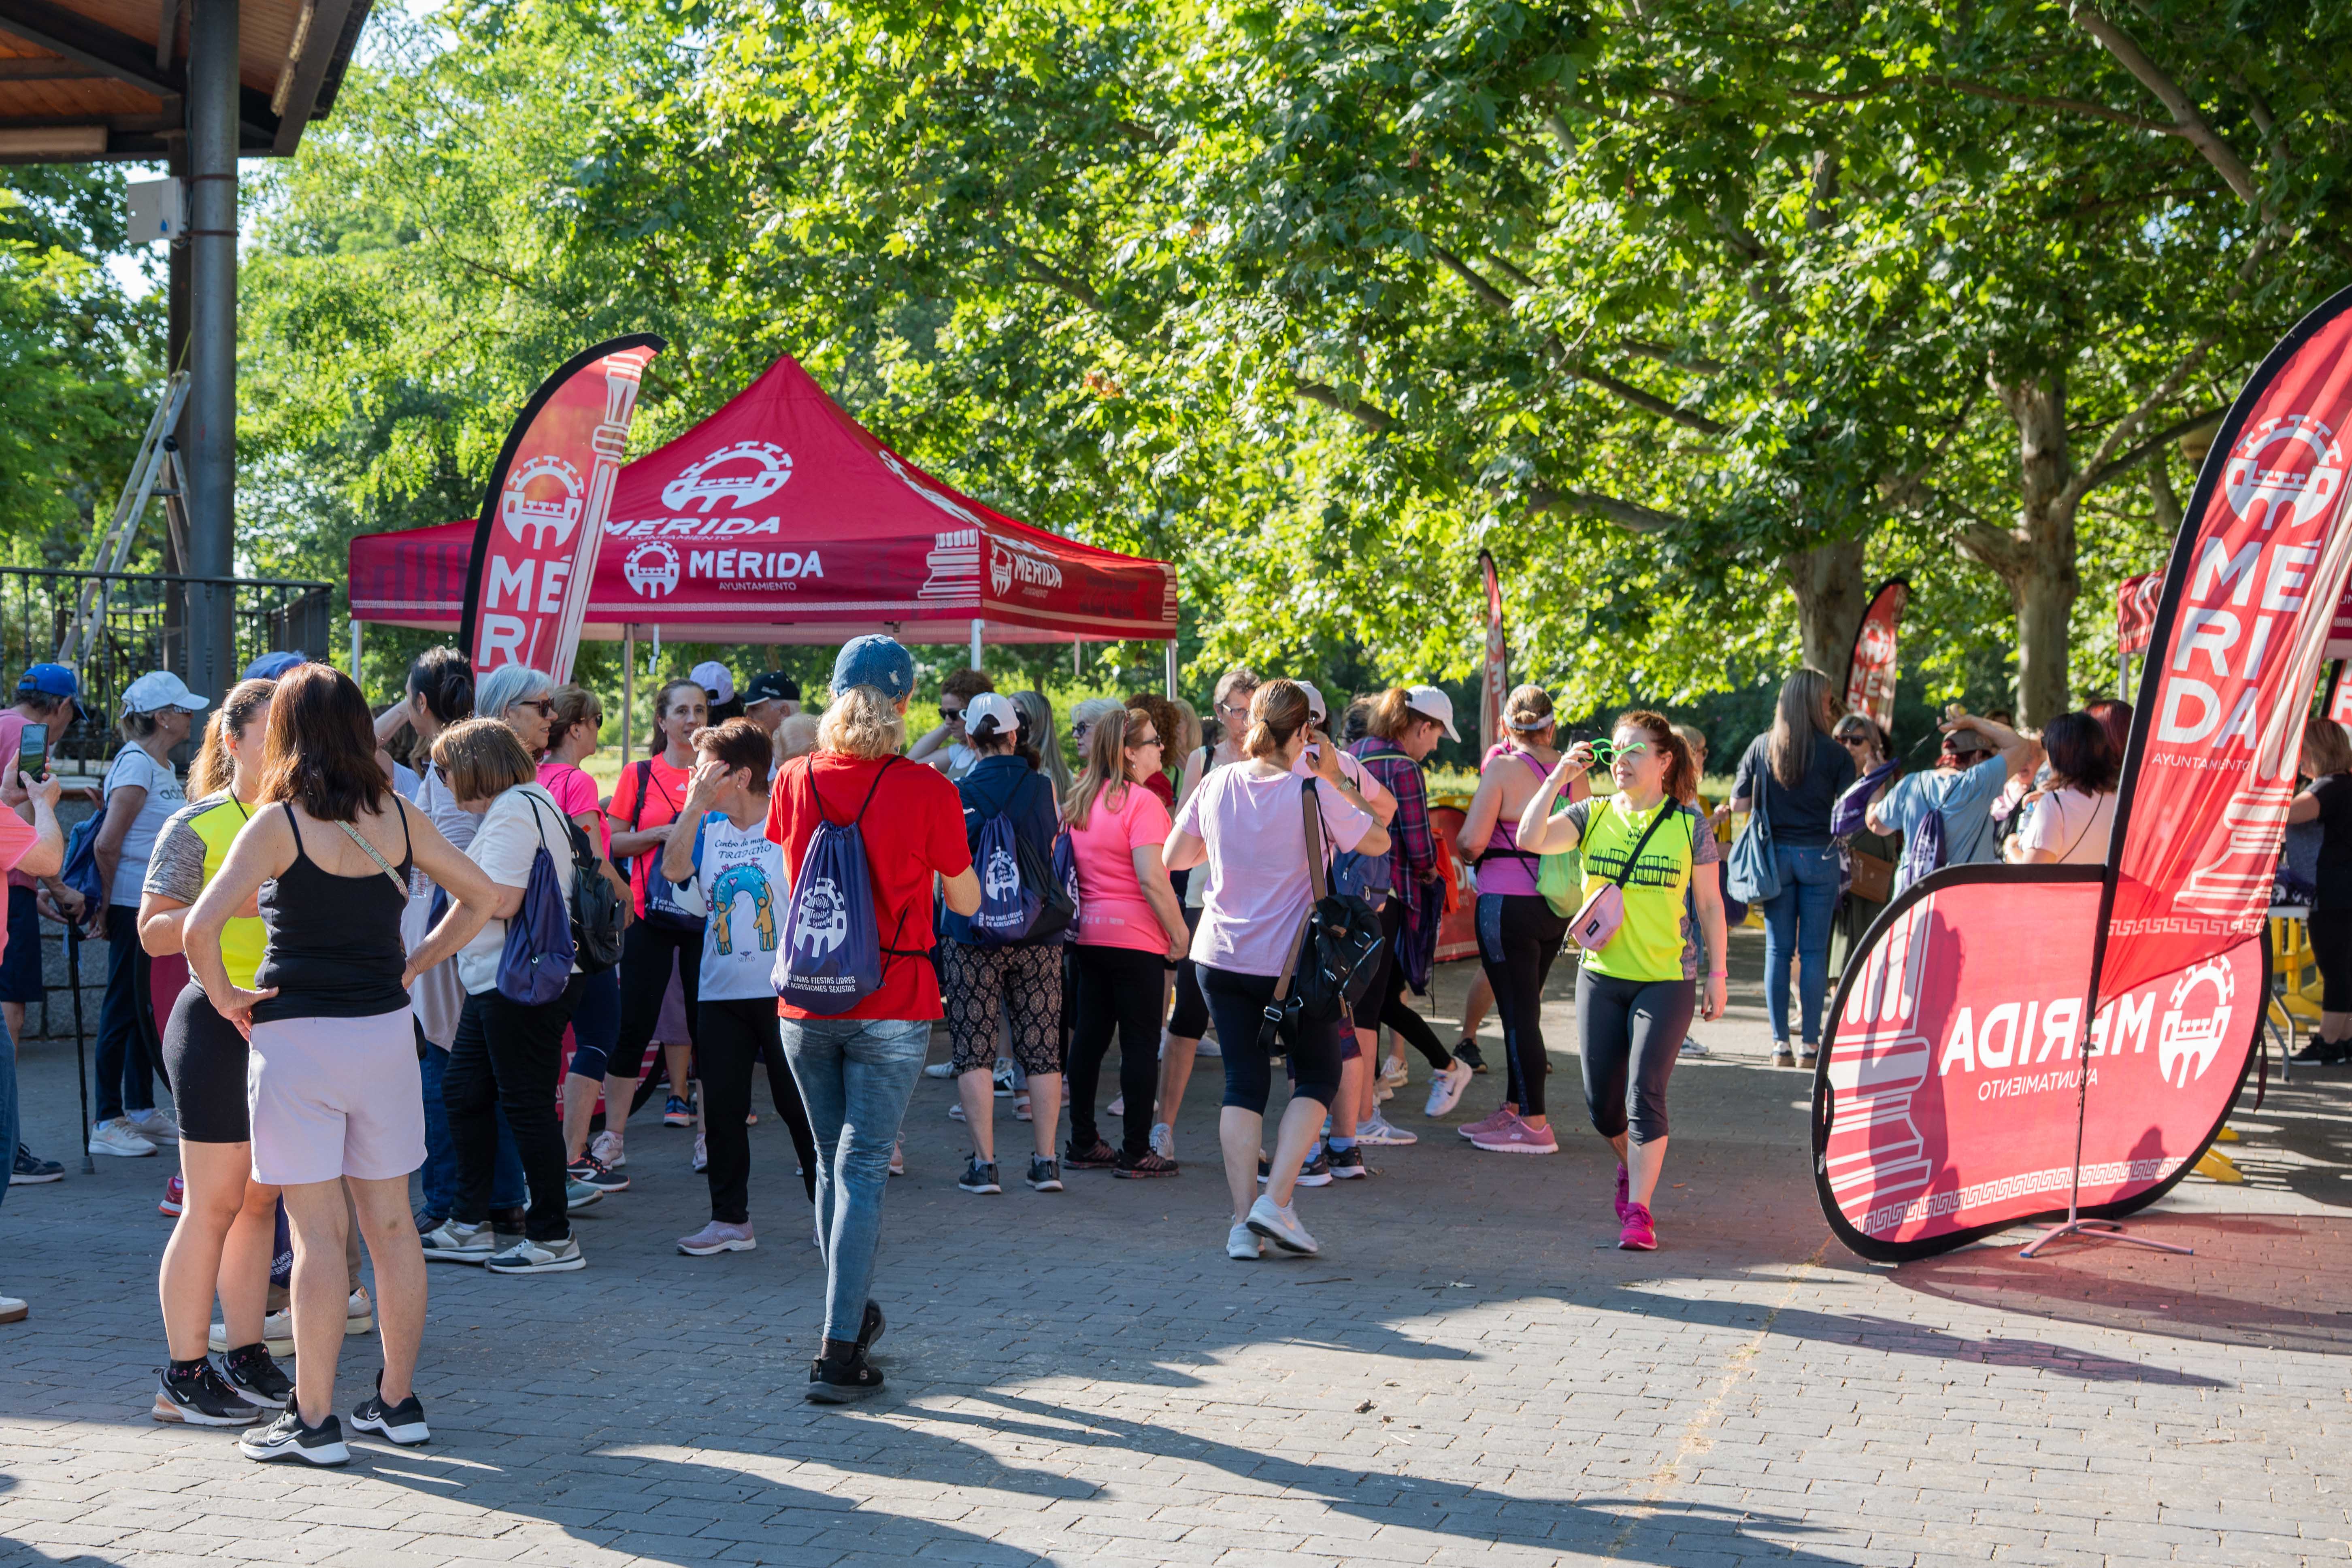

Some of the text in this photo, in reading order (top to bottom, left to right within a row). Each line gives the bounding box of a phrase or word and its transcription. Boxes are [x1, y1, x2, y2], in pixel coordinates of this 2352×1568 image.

[689, 548, 824, 579] MÉRIDA
[2191, 537, 2321, 612] MÉ
[719, 581, 797, 591] AYUNTAMIENTO
[793, 974, 809, 983] UNAS
[811, 977, 834, 985] FIESTAS
[836, 976, 856, 985] LIBRES
[791, 982, 827, 993] AGRESIONES
[829, 985, 856, 993] SEXISTAS
